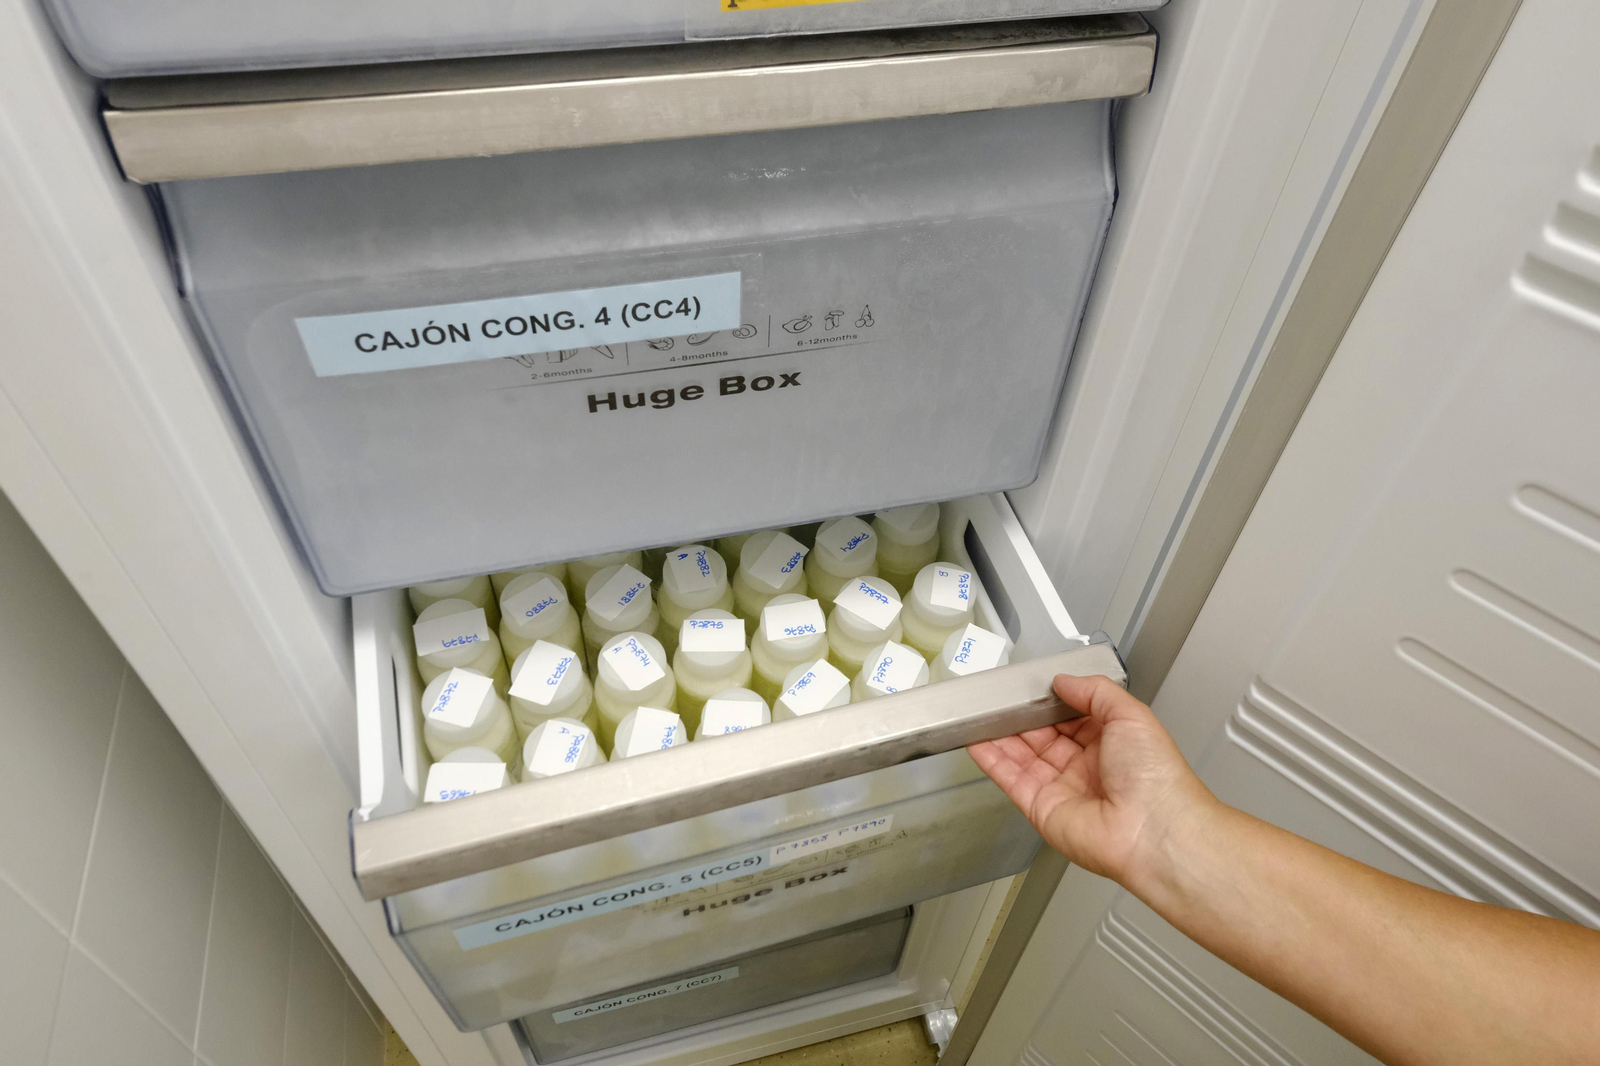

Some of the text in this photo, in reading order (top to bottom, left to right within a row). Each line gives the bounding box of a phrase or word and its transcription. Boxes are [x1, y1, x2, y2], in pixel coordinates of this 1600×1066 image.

[353, 294, 703, 354] CAJÓN CONG. 4 (CC4)
[796, 333, 858, 347] 6-12months
[669, 349, 729, 363] 4-8months
[530, 366, 594, 381] 2-6months
[587, 371, 802, 414] Huge Box
[618, 582, 645, 606] P7881
[858, 582, 889, 605] P7877
[958, 573, 970, 600] P7878
[525, 596, 558, 618] P7880
[690, 620, 724, 630] P7875
[784, 624, 817, 636] P7876
[626, 638, 651, 667] P7874
[954, 638, 977, 664] P7871
[432, 681, 459, 713] P7872
[784, 866, 849, 889] Box
[494, 903, 585, 933] CAJÓN
[592, 883, 672, 907] CONG.
[680, 874, 693, 884] 5
[700, 855, 763, 881] (CC5)
[574, 1000, 622, 1017] CAJÓN
[626, 988, 671, 1003] CONG.
[686, 974, 722, 989] (CC7)
